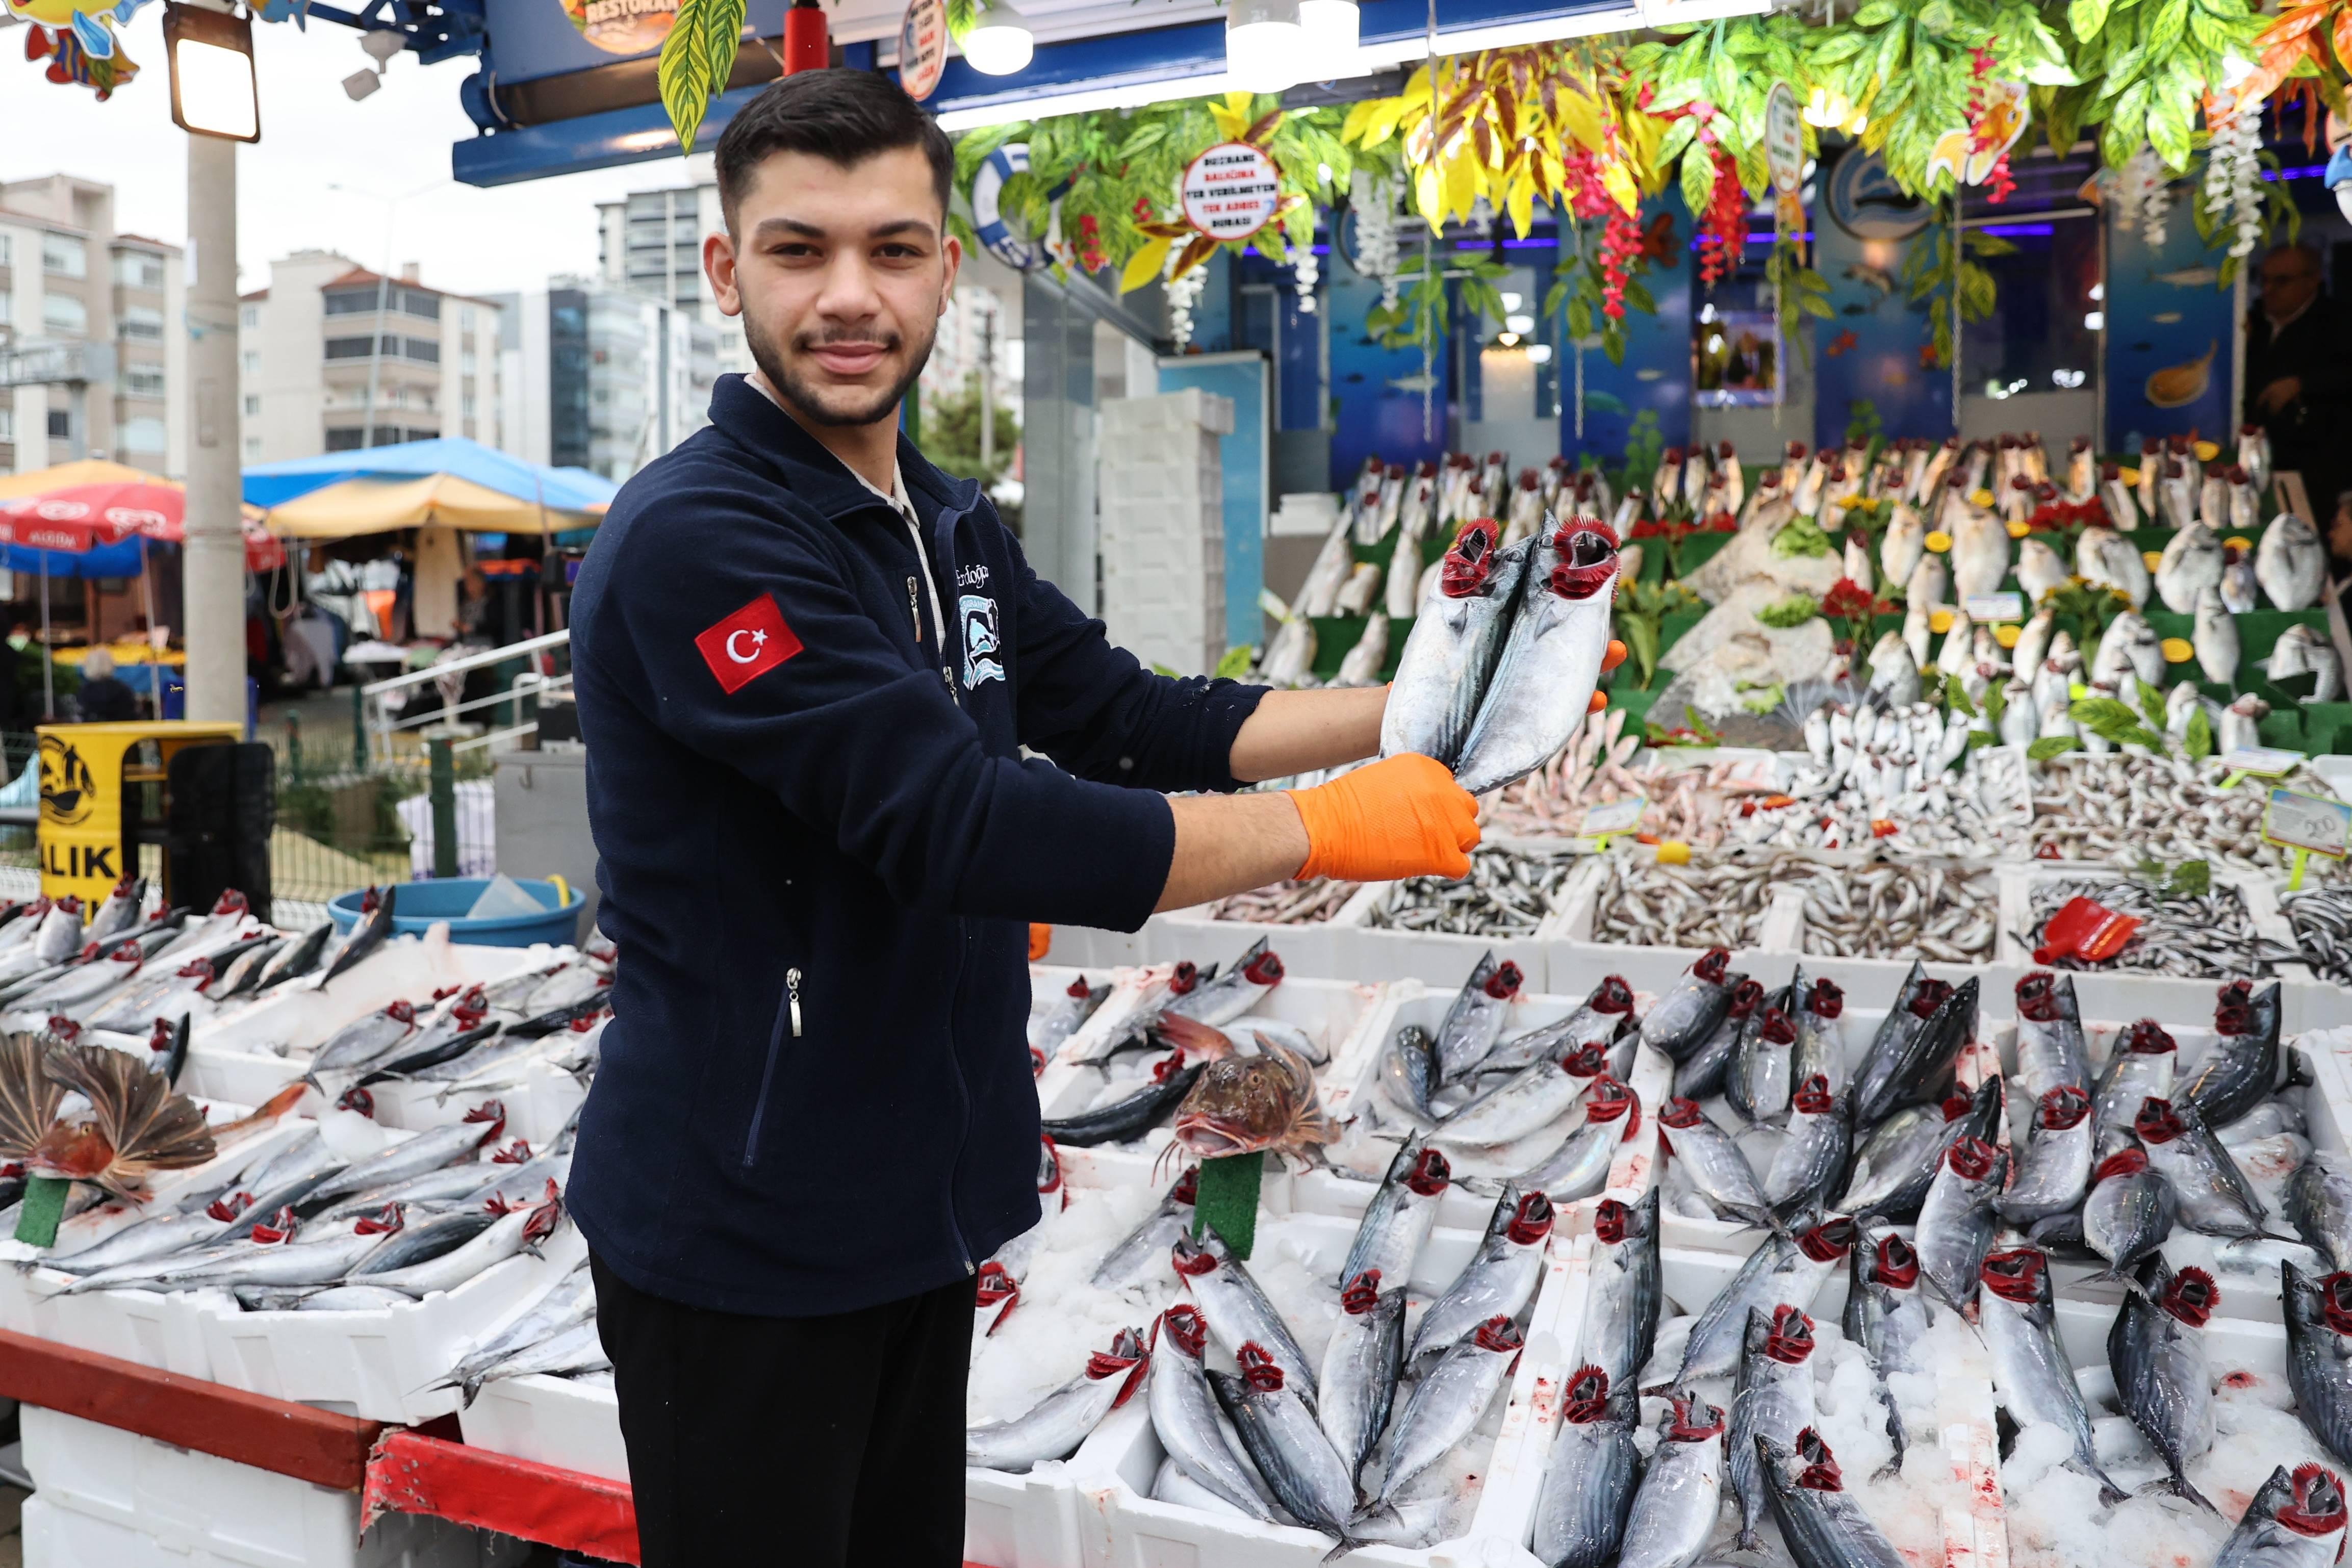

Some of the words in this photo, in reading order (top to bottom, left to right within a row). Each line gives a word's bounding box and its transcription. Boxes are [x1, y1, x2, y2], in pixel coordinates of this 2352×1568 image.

[1203, 204, 1221, 213] TEK
[1226, 201, 1260, 211] ADRES
[1212, 218, 1251, 227] BURASI
